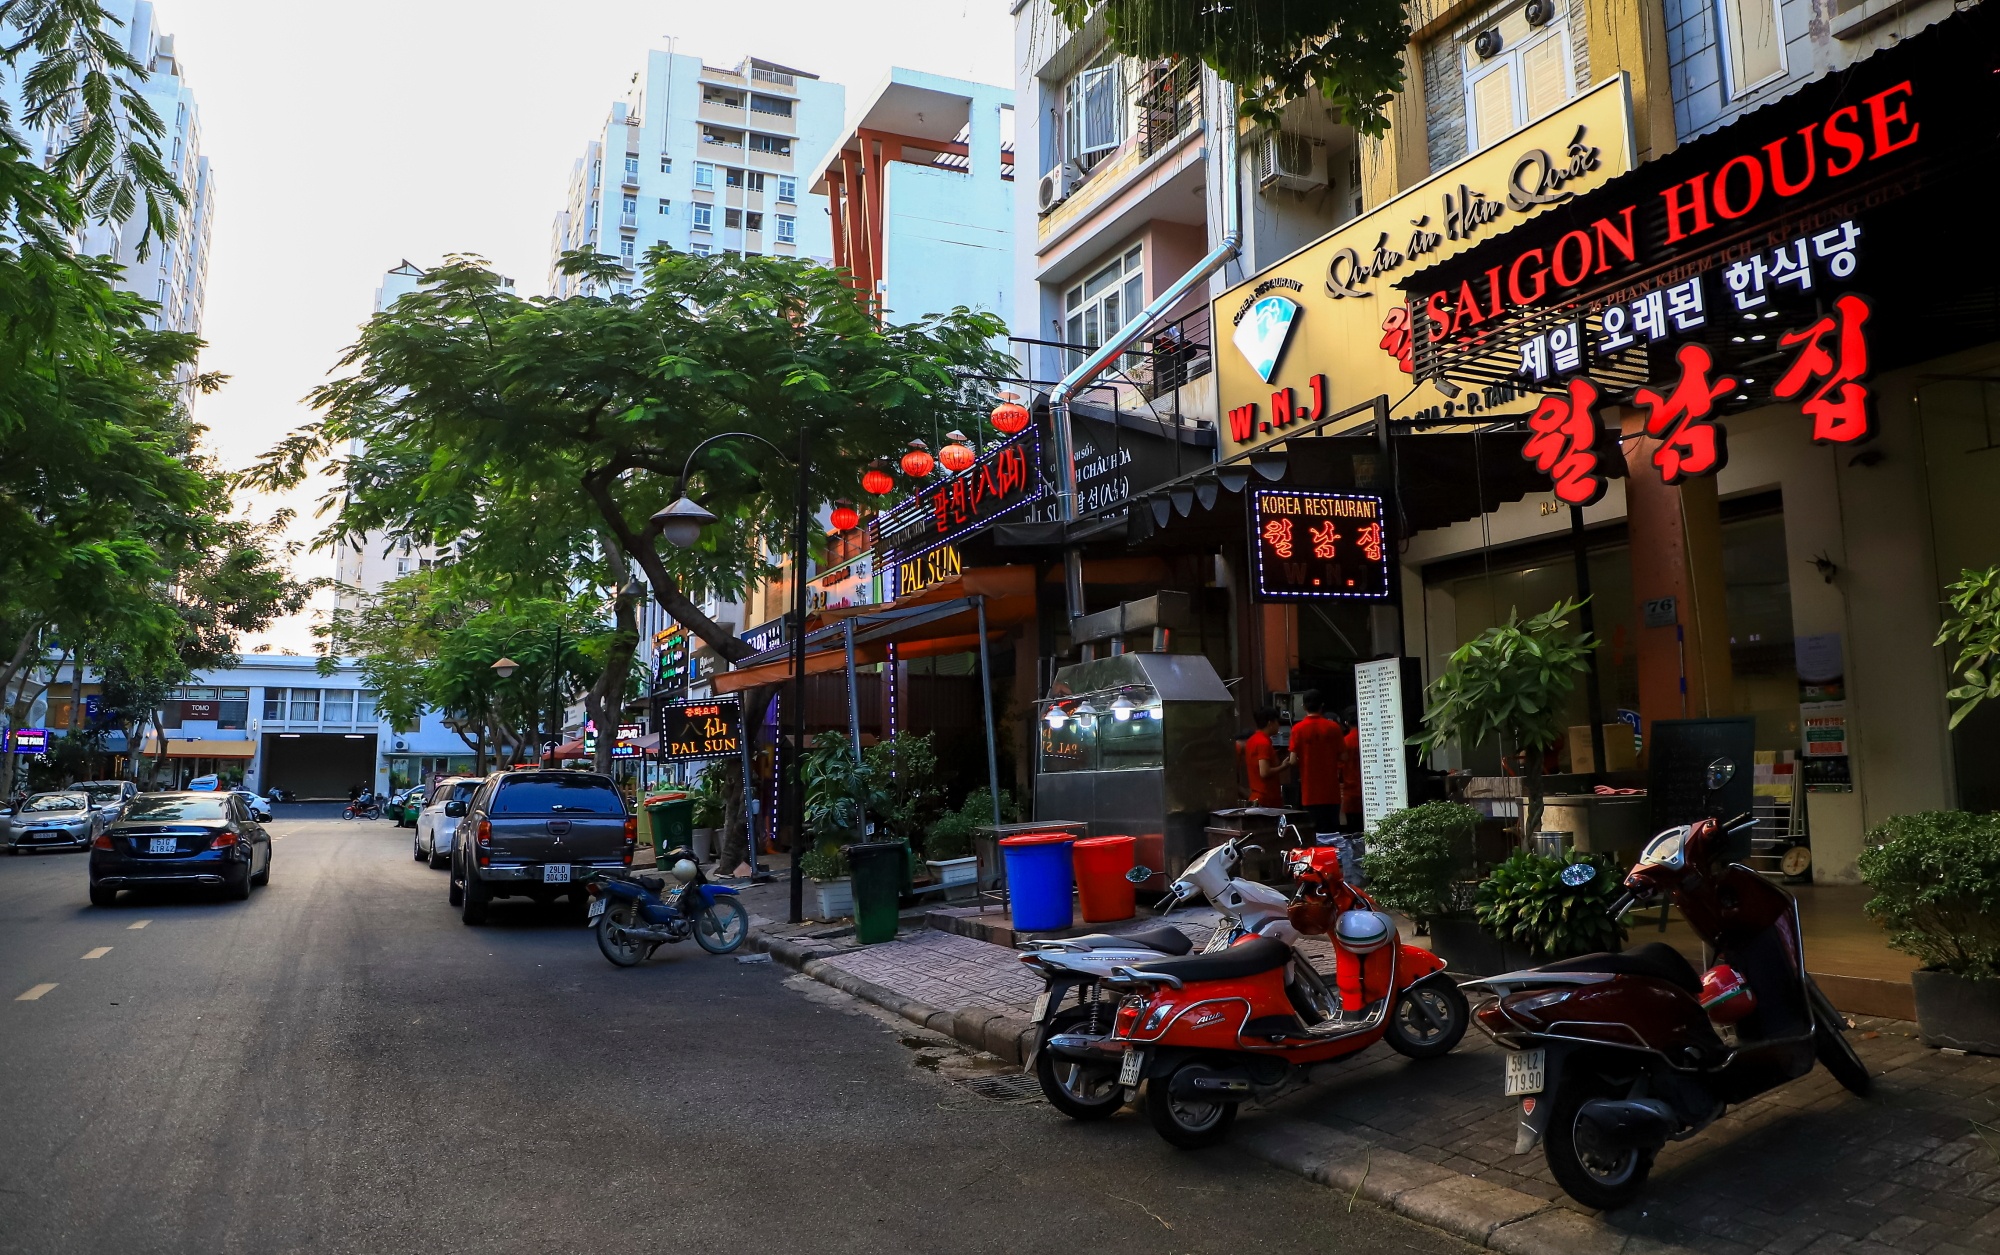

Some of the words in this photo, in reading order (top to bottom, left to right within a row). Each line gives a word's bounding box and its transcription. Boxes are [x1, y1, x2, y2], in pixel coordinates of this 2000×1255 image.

[1323, 232, 1402, 299] Quán
[1405, 214, 1440, 261] ăn
[1442, 184, 1503, 241] Hàn
[1506, 124, 1601, 212] Quốc
[1426, 206, 1635, 343] SAIGON
[1659, 79, 1920, 246] HOUSE
[1518, 322, 1580, 382] 제일
[1600, 278, 1706, 352] 오래된
[1725, 219, 1862, 310] 한식당
[1228, 373, 1327, 444] W.N.J
[1261, 495, 1302, 515] KOREA
[1305, 498, 1377, 518] RESTAURANT
[900, 561, 926, 596] PAL
[927, 545, 962, 583] SUN
[1648, 598, 1672, 613] 76
[191, 704, 210, 712] TOMO
[684, 706, 720, 718] 중화요리
[17, 736, 29, 745] THE
[29, 736, 44, 745] PARK
[671, 741, 699, 755] PAL
[704, 737, 736, 752] SUN
[546, 874, 568, 882] 304.39
[1511, 1052, 1539, 1073] 59-L2
[1509, 1071, 1541, 1093] 719.90
